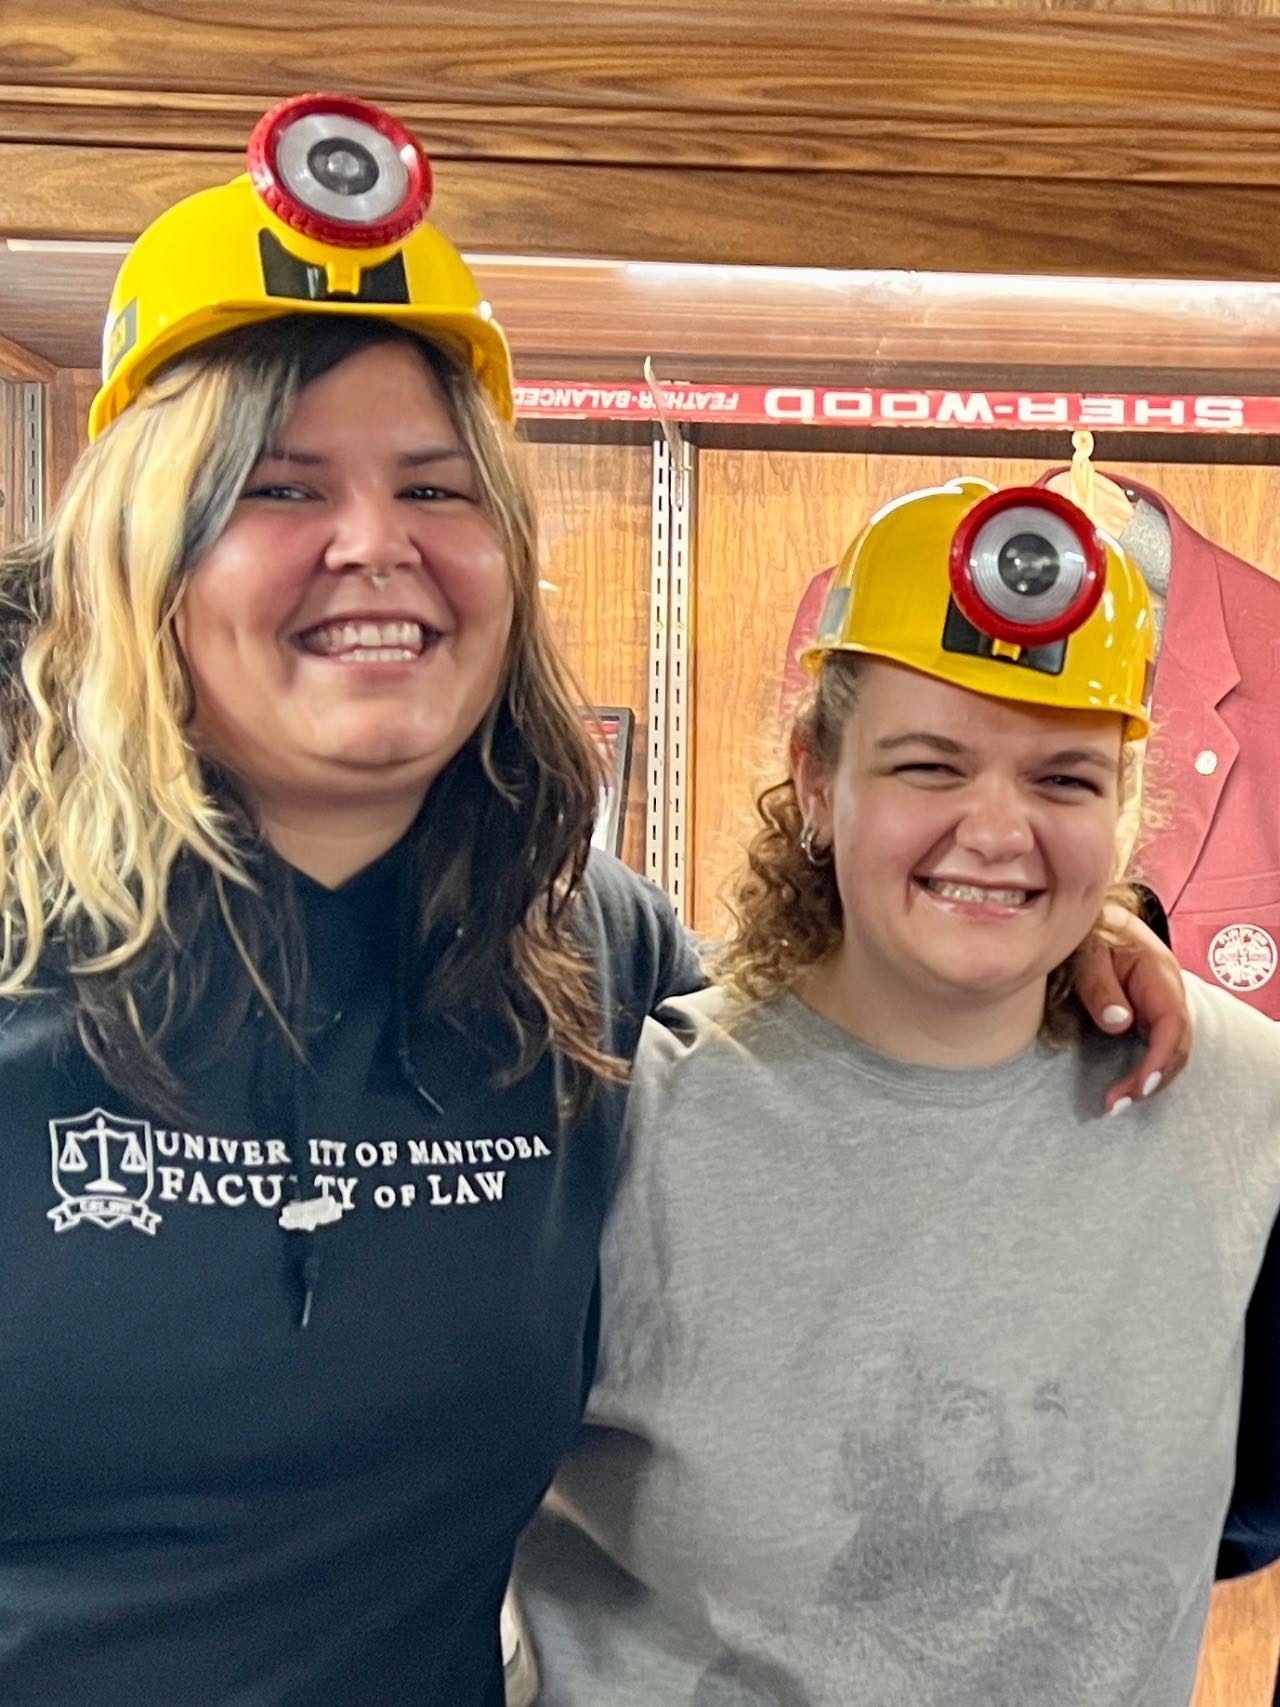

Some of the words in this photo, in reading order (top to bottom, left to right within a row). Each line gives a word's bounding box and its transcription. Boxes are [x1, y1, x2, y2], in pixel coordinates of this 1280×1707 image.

[764, 387, 1245, 428] SHER-WOOD
[155, 1130, 347, 1168] UNIVERITY
[354, 1142, 399, 1169] OF
[410, 1134, 551, 1166] MANITOBA
[158, 1166, 358, 1212] FACUTY
[374, 1181, 416, 1209] OF
[427, 1170, 507, 1206] LAW
